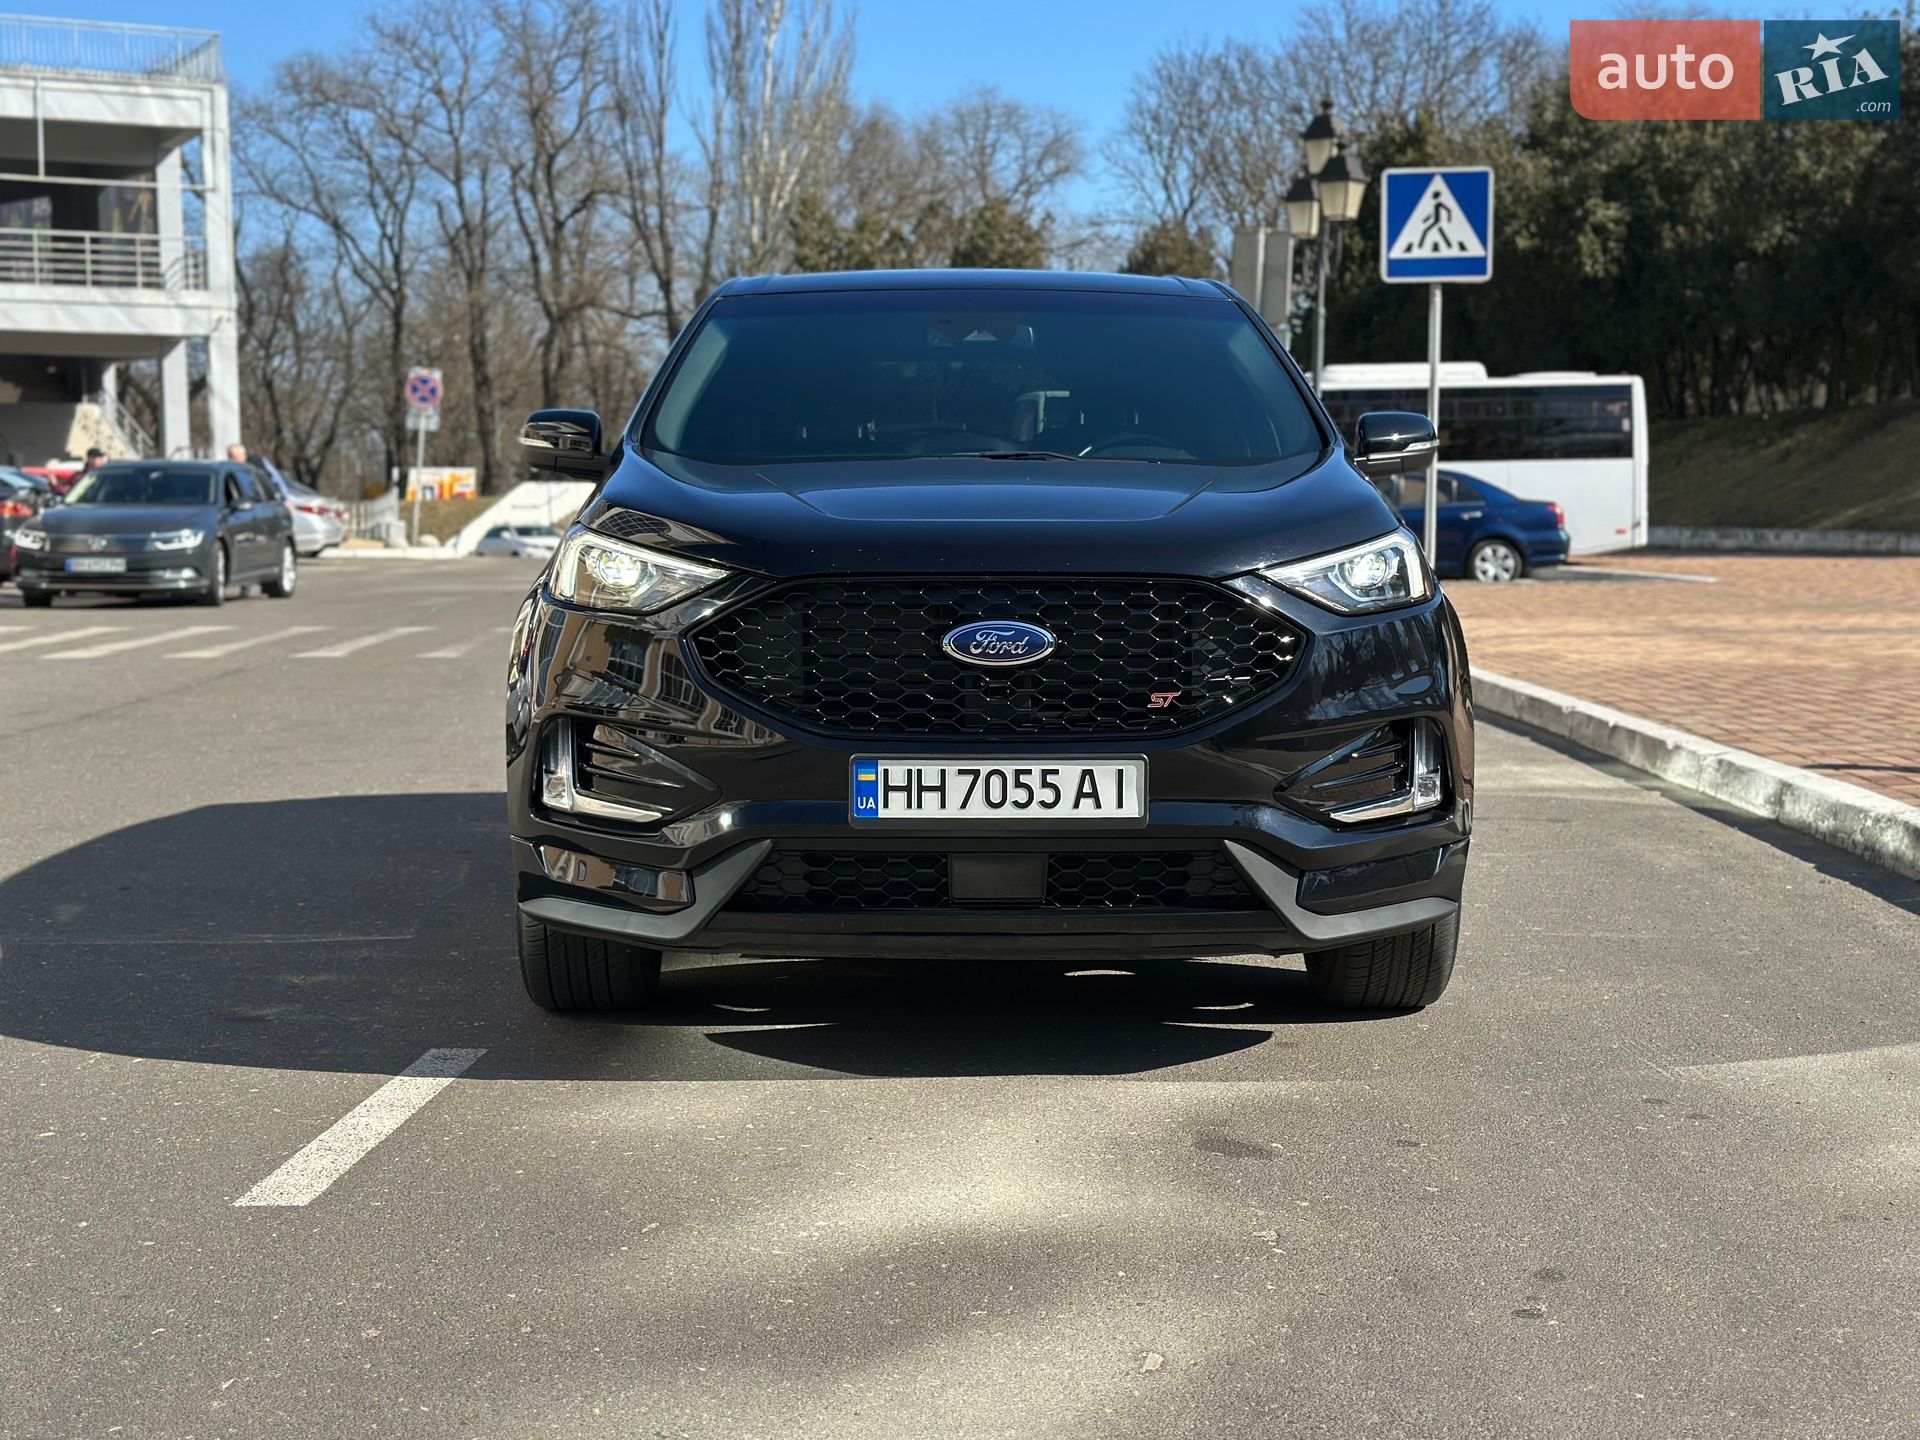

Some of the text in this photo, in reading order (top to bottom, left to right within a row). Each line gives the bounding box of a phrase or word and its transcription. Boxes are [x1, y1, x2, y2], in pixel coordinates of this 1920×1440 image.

[969, 630, 1029, 655] Ford
[1147, 690, 1182, 708] ST
[857, 796, 876, 810] UA
